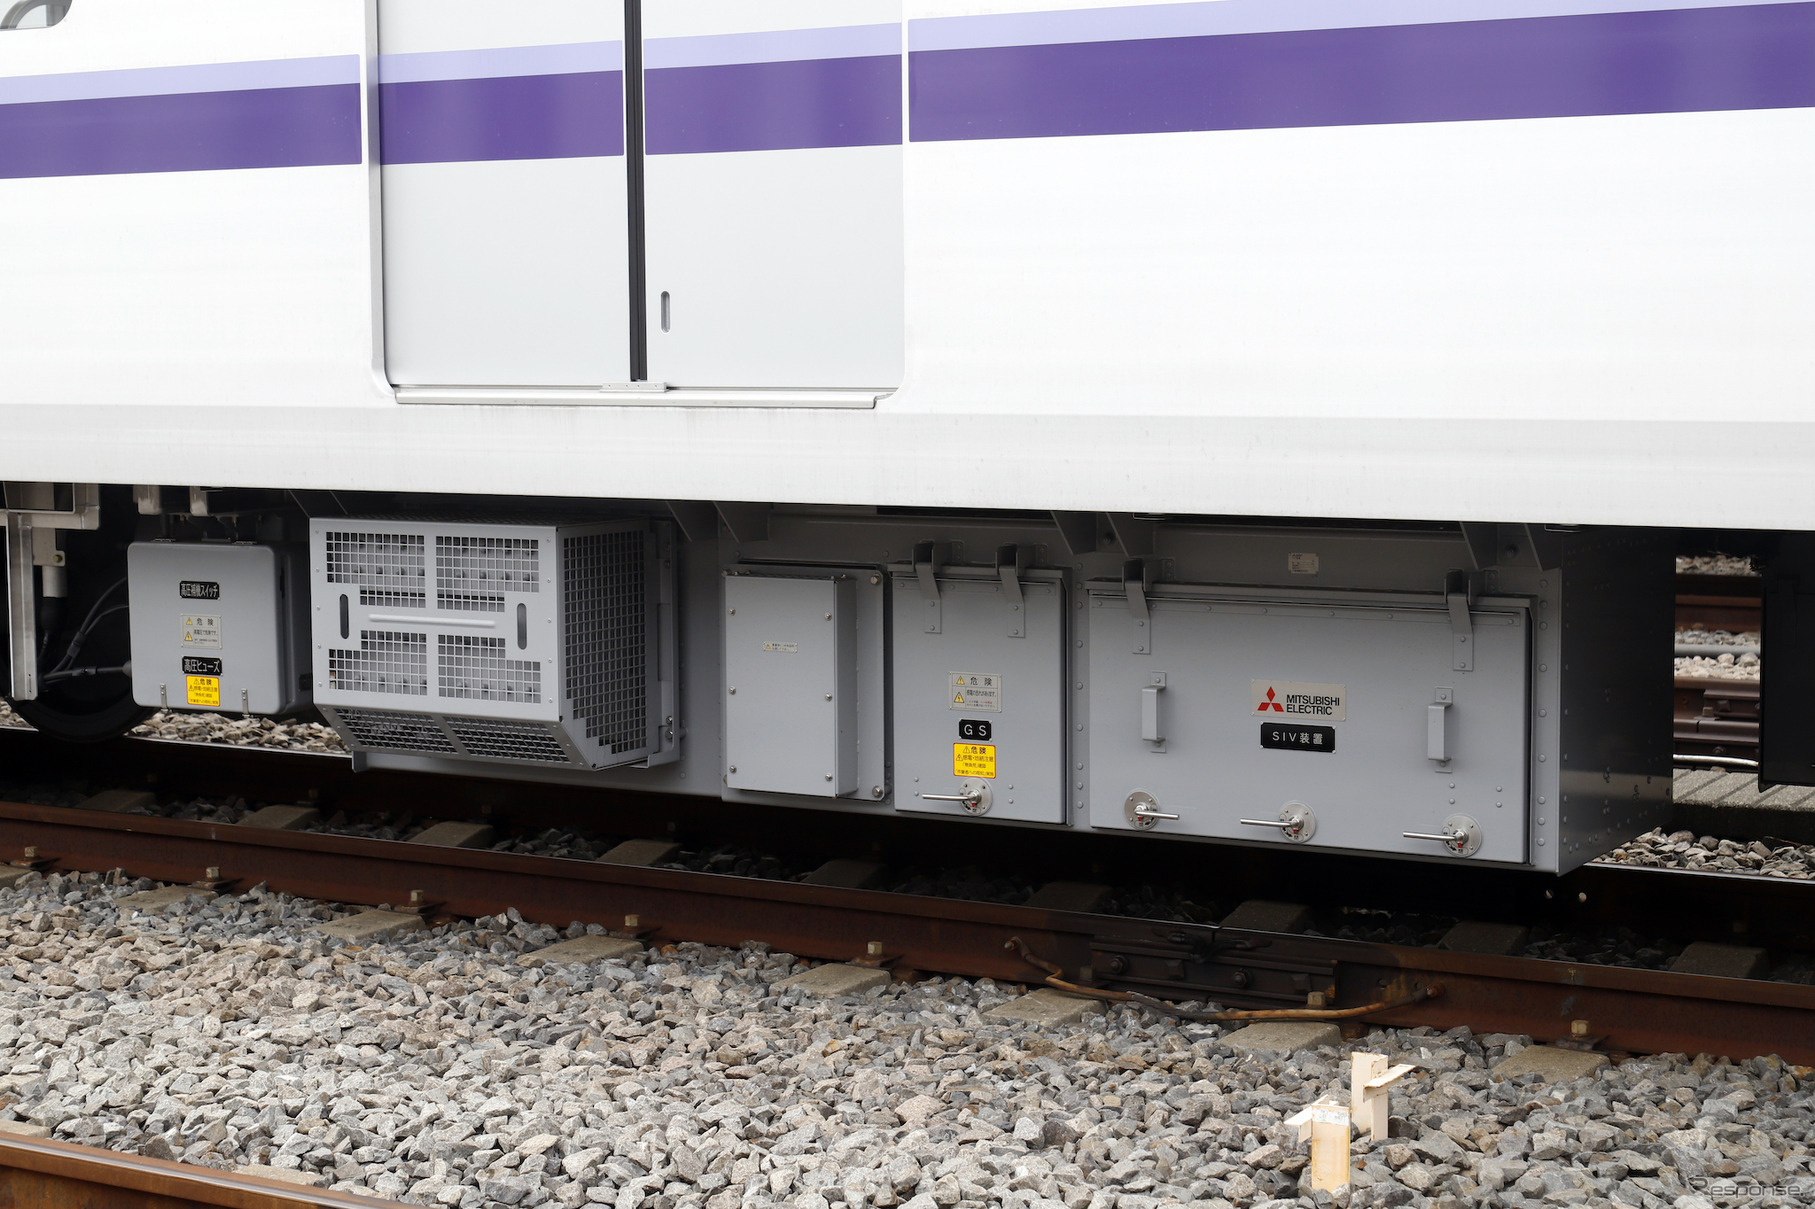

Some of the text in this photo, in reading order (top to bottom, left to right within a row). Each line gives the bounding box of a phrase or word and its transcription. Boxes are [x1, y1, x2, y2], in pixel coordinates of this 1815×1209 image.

[196, 617, 214, 626] 危険
[184, 659, 220, 673] 高圧ヒューズ
[970, 677, 992, 686] 危険
[1286, 694, 1340, 706] MITSUBISHI
[1286, 704, 1333, 715] ELECTRIC
[1272, 731, 1323, 745] SIV装置
[971, 746, 987, 754] 危険
